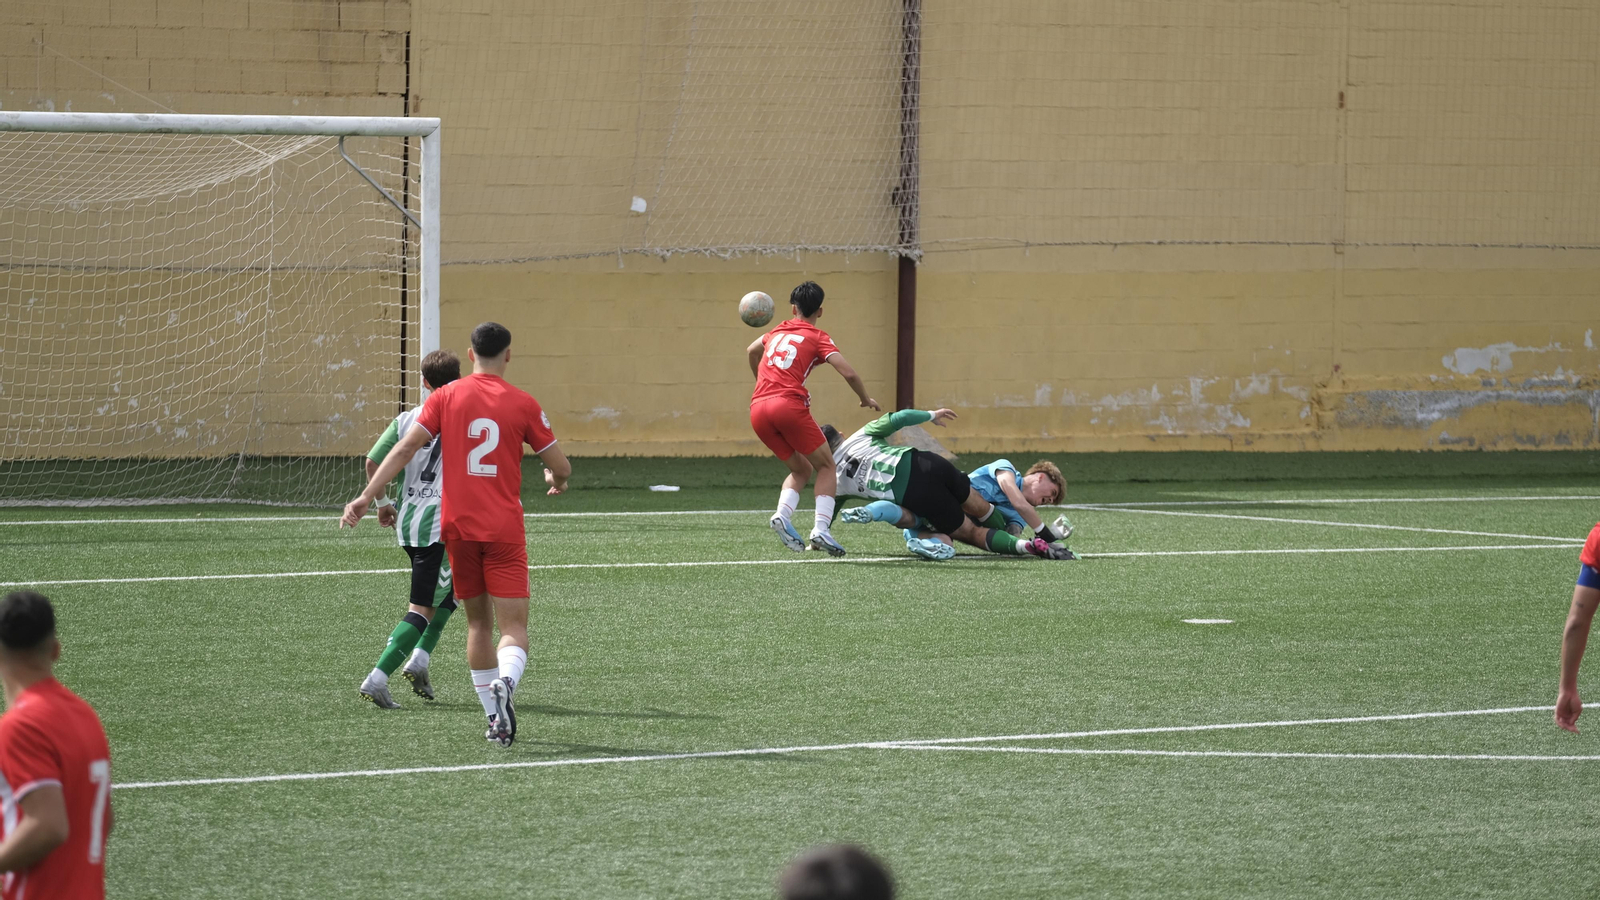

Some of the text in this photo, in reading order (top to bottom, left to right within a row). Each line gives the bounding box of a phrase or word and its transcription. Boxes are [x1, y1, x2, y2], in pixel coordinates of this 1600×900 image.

[766, 333, 805, 370] 15
[467, 417, 500, 477] 2
[858, 456, 869, 486] MEDA
[88, 758, 109, 864] 7
